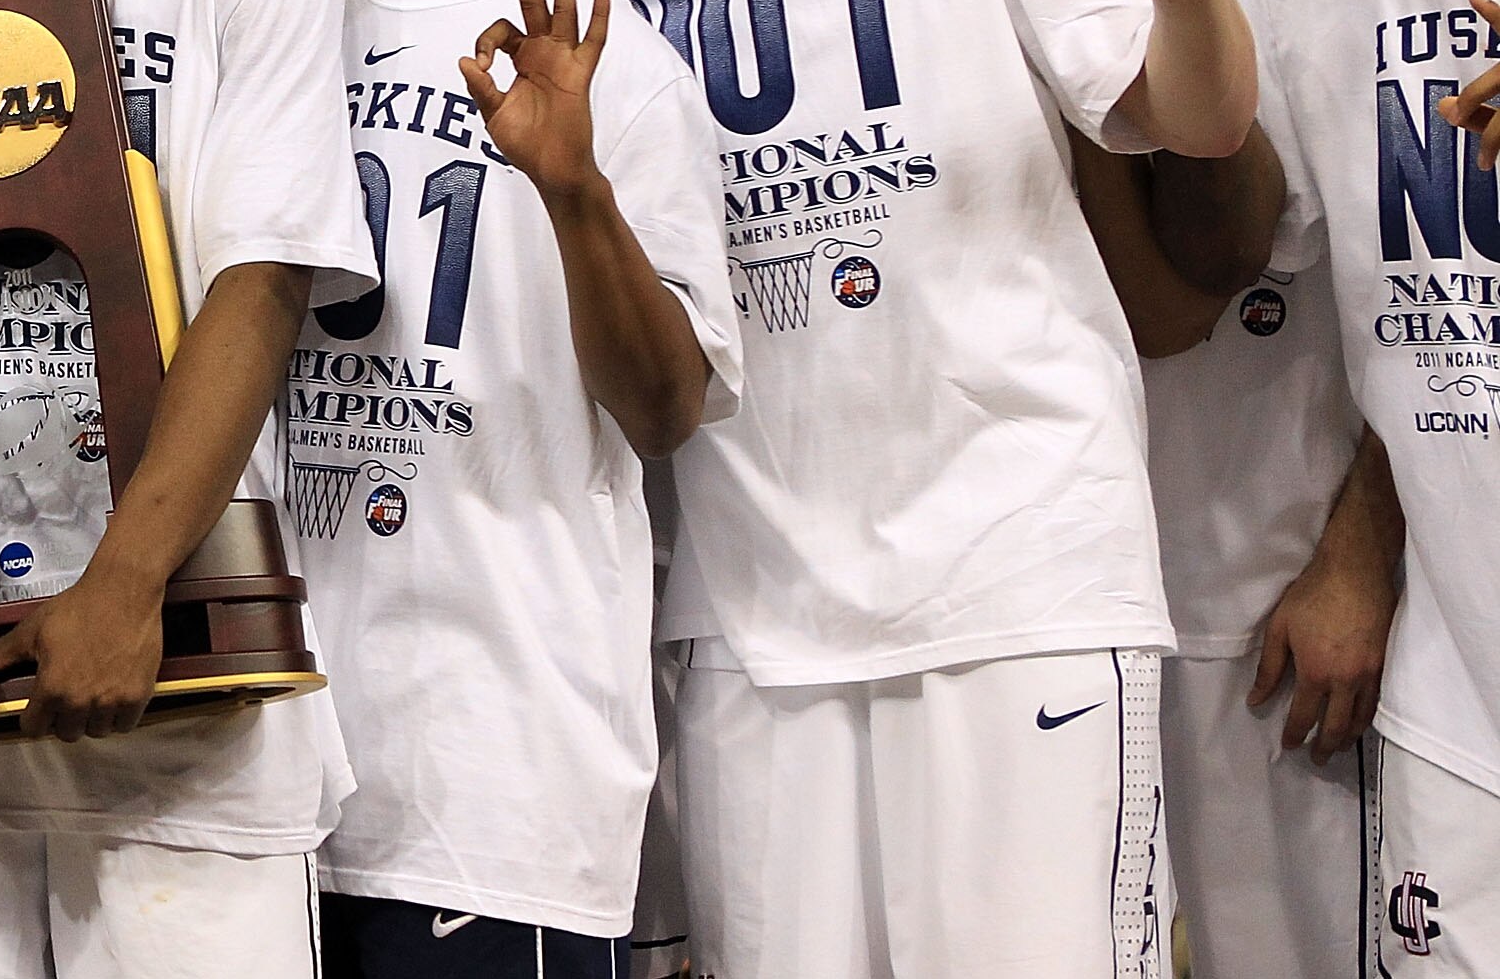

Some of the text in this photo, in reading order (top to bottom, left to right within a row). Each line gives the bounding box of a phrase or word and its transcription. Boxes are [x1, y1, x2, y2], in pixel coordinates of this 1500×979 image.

[794, 203, 891, 237] BASKETBALL
[418, 159, 488, 350] 1
[3, 267, 32, 288] 2011
[844, 268, 874, 281] FINAL
[1253, 299, 1281, 310] FINAL
[1415, 352, 1441, 369] 2011
[288, 387, 476, 438] MPIONS
[1414, 412, 1489, 440] UCONN
[347, 433, 426, 456] BASKETBALL
[378, 495, 402, 508] FINAL
[3, 557, 34, 571] NCAA
